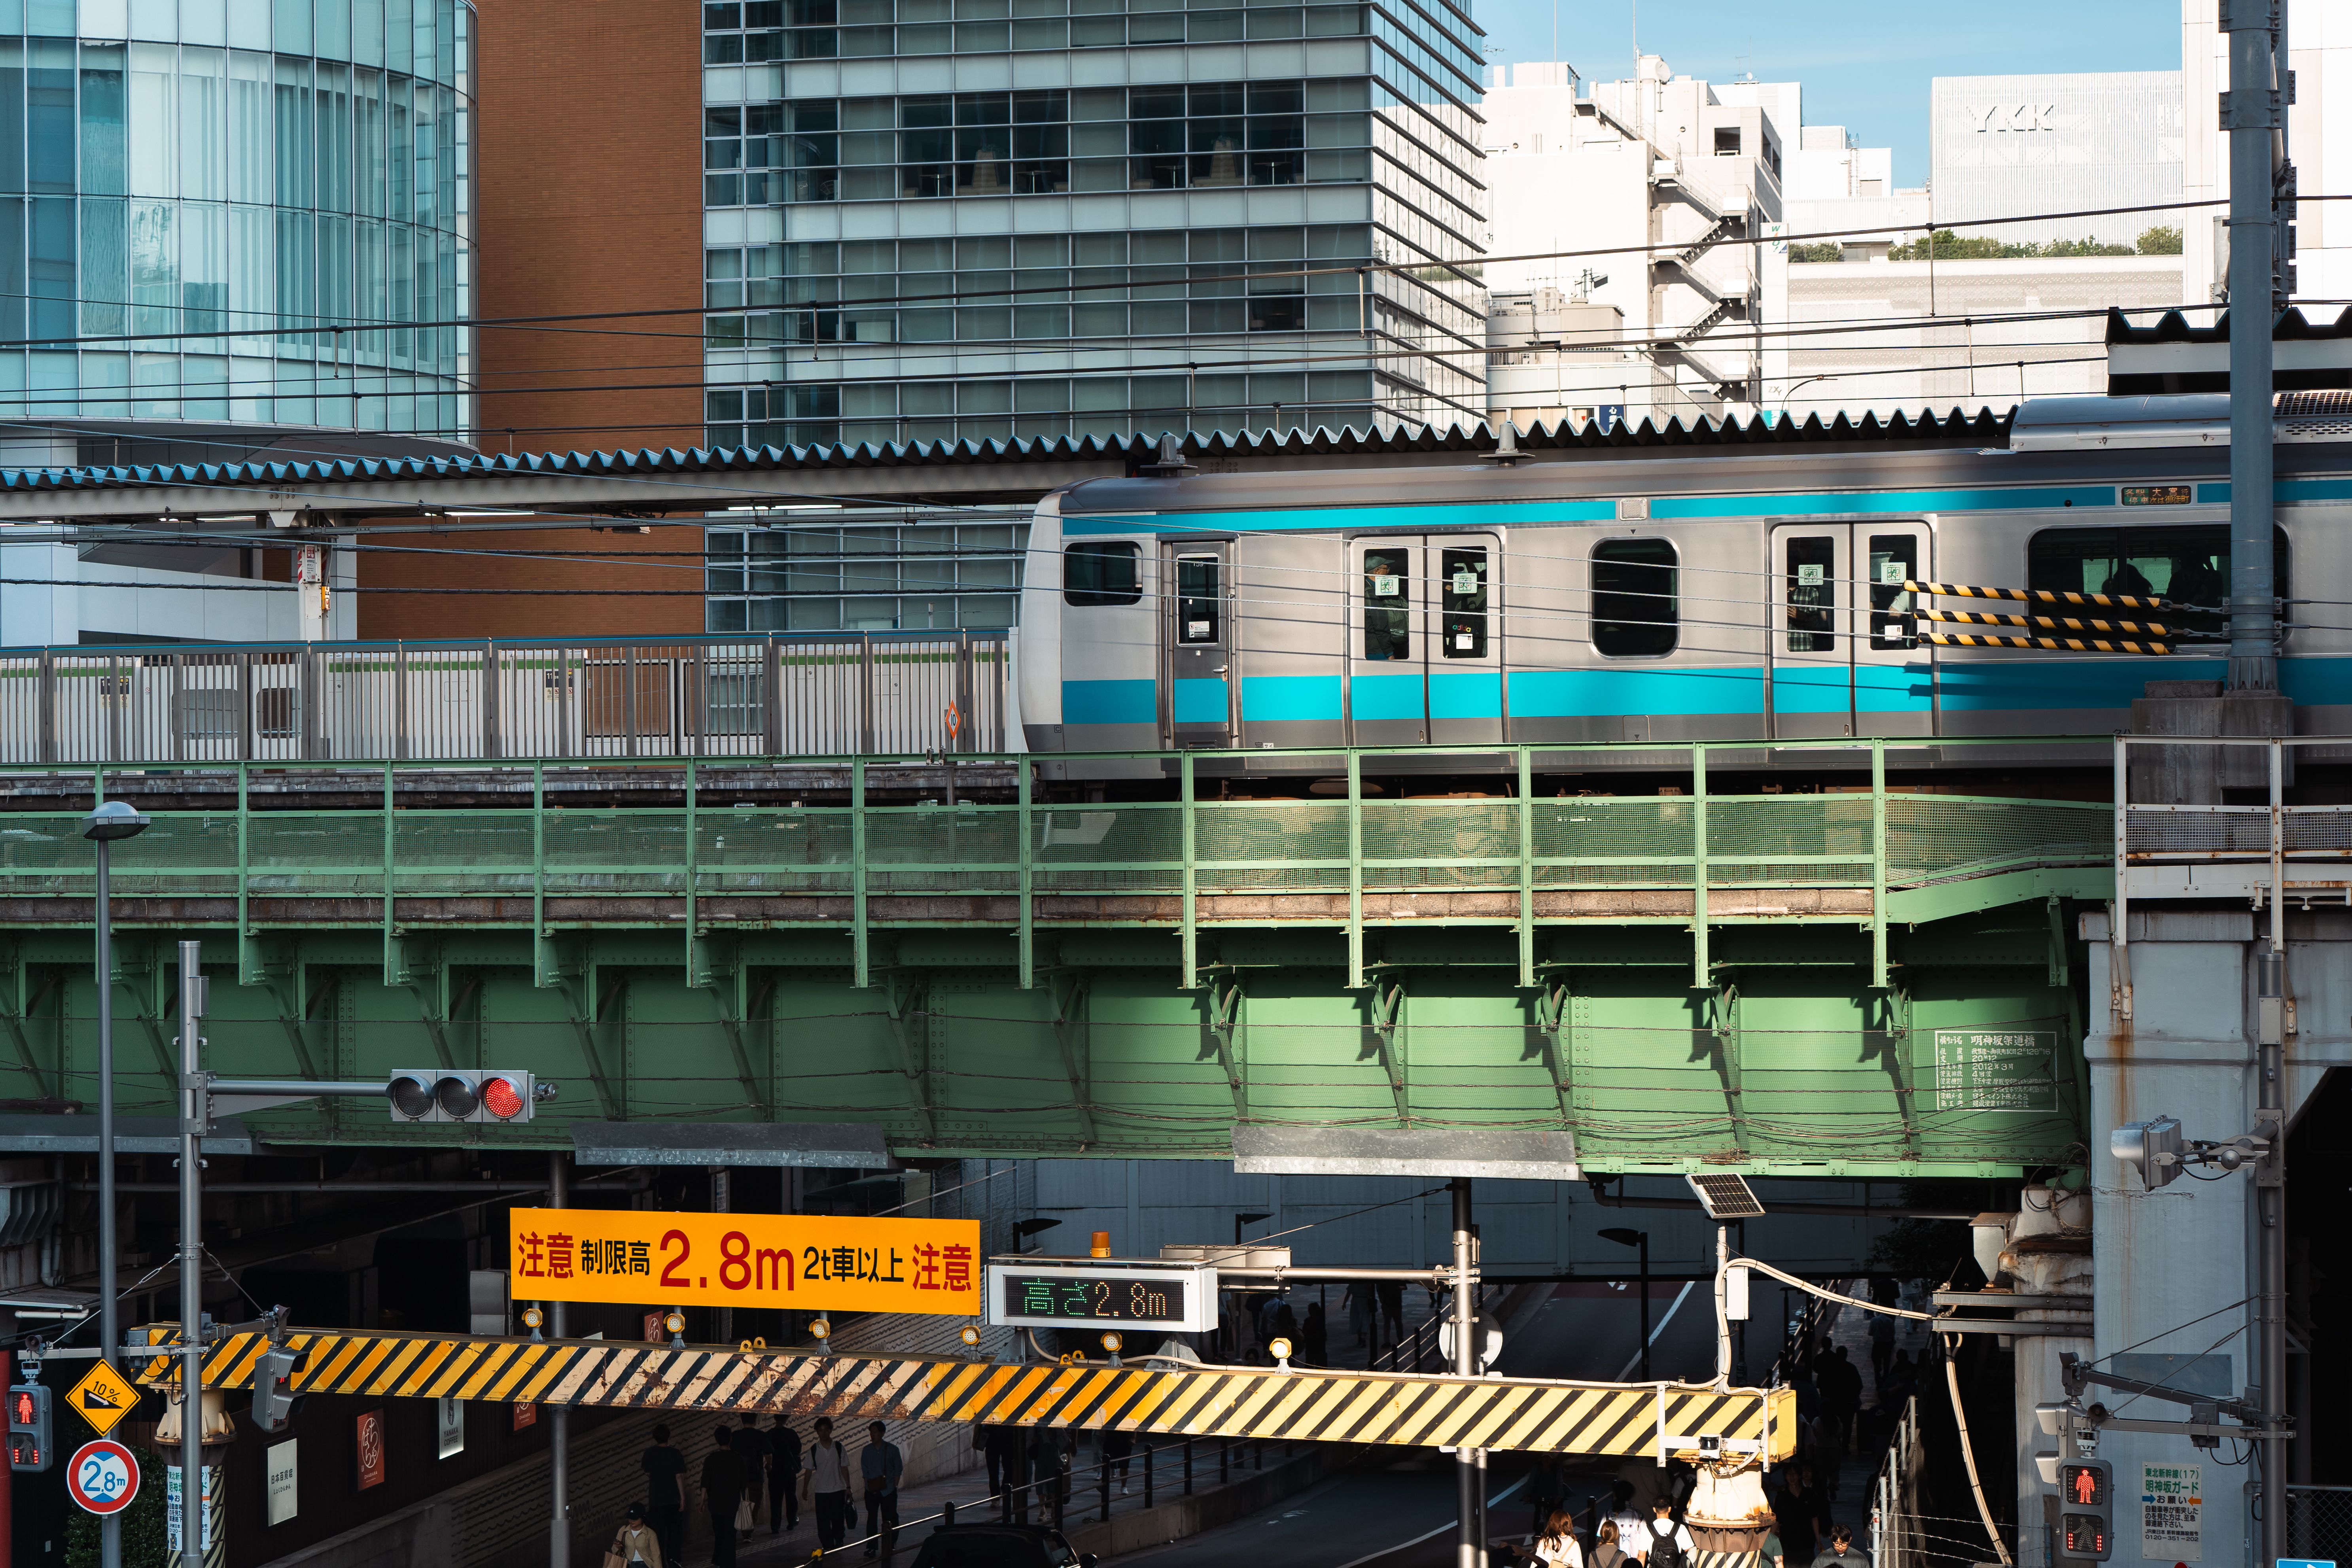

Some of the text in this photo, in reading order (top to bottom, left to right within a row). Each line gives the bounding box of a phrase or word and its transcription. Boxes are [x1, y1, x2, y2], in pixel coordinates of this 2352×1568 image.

[1967, 104, 2054, 132] YKK
[1769, 386, 1782, 396] ZXY
[951, 713, 956, 726] 10
[518, 1229, 972, 1292] 注意 制限高 2.8m 2t車以上 注意
[93, 1381, 121, 1402] 10%
[443, 1426, 458, 1438] YANAKA
[443, 1434, 458, 1447] COFFEE
[83, 1460, 125, 1492] 2.8m
[364, 1471, 378, 1479] CHABARA
[2145, 1468, 2199, 1479] 東北新幹線(17)
[2145, 1480, 2199, 1494] 明神坂ガード
[2157, 1495, 2187, 1504] お願い
[2145, 1505, 2199, 1515] 自動車等が衝突した
[2145, 1513, 2196, 1522] のを見た方は、至急
